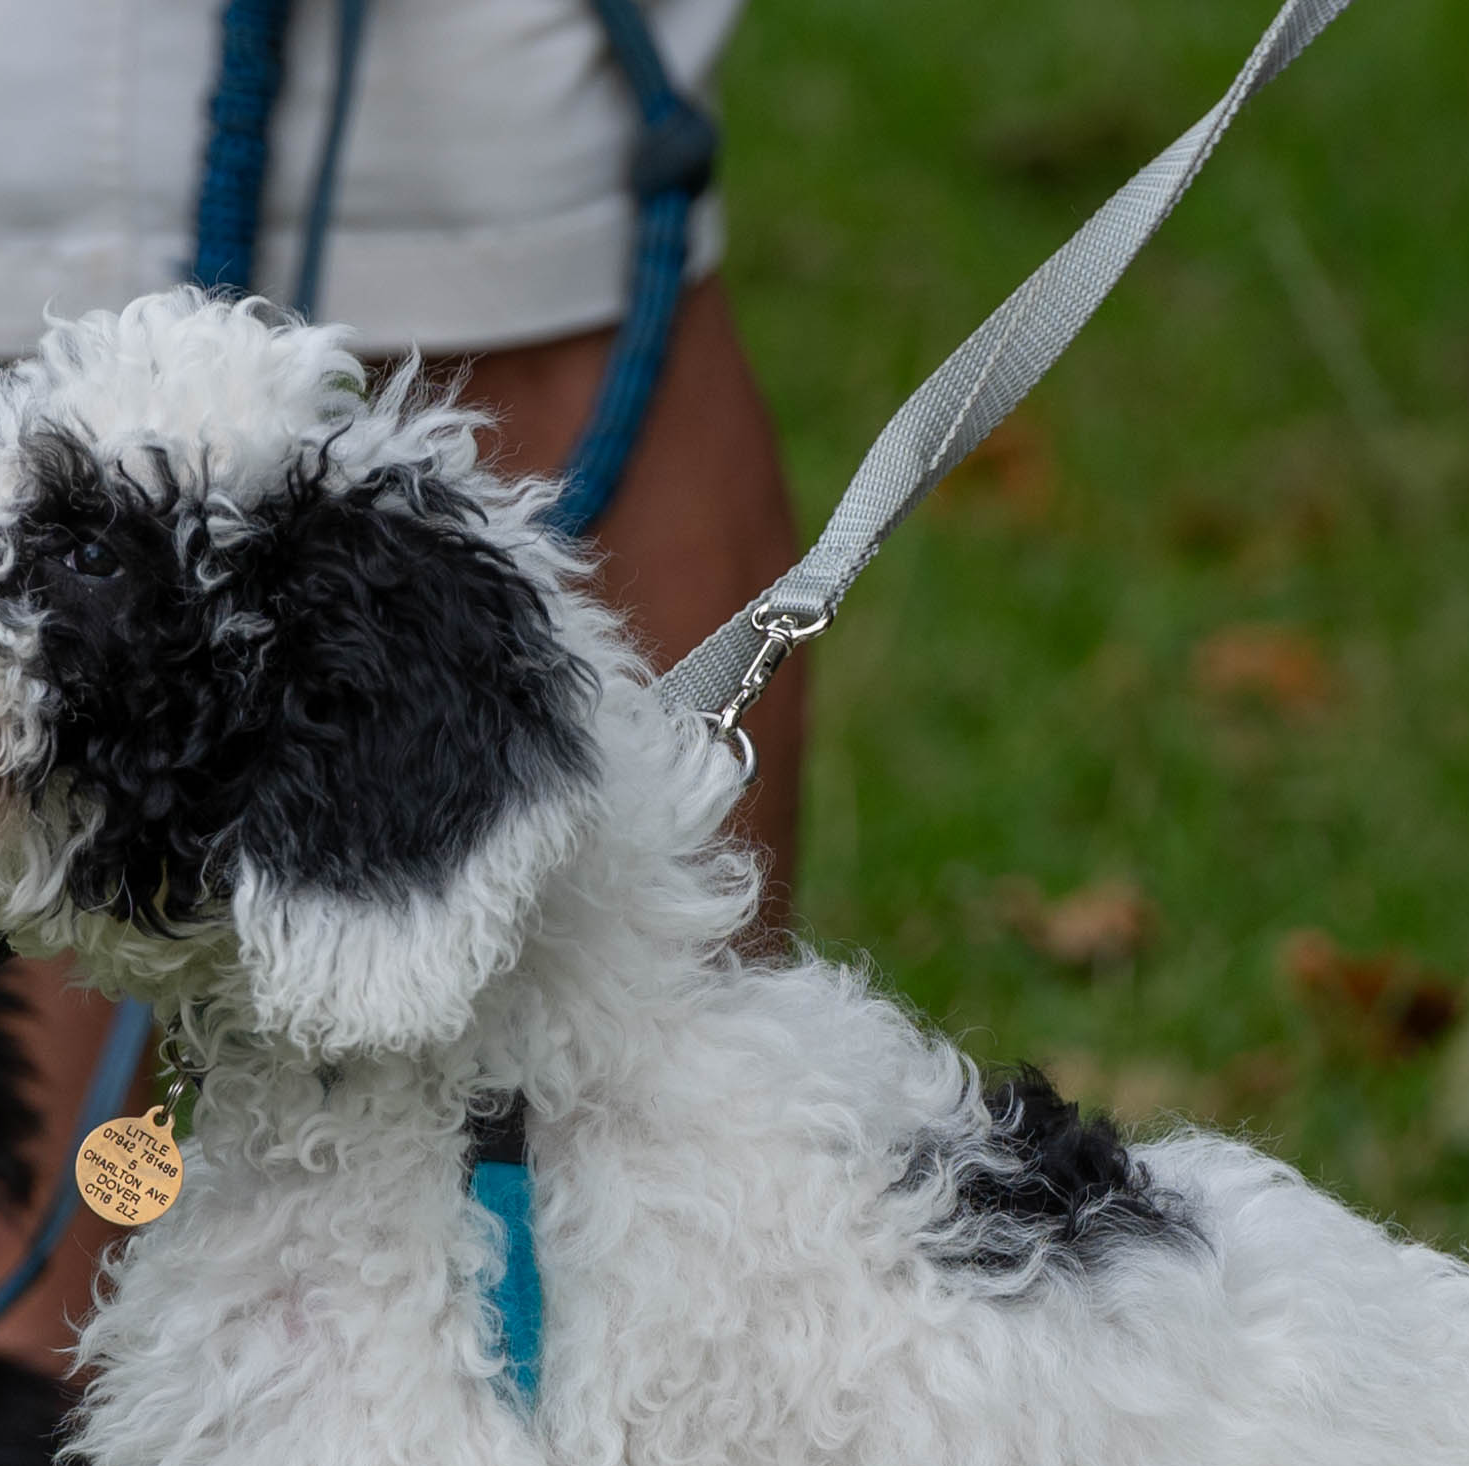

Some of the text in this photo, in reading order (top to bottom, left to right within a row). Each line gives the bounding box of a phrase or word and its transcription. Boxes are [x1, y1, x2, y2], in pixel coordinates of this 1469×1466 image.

[103, 1127, 135, 1153] 07942
[126, 1125, 170, 1156] LITTLE
[83, 1149, 169, 1205] CHARLTON AVE
[128, 1160, 138, 1170] 5
[96, 1173, 141, 1205] DOVER
